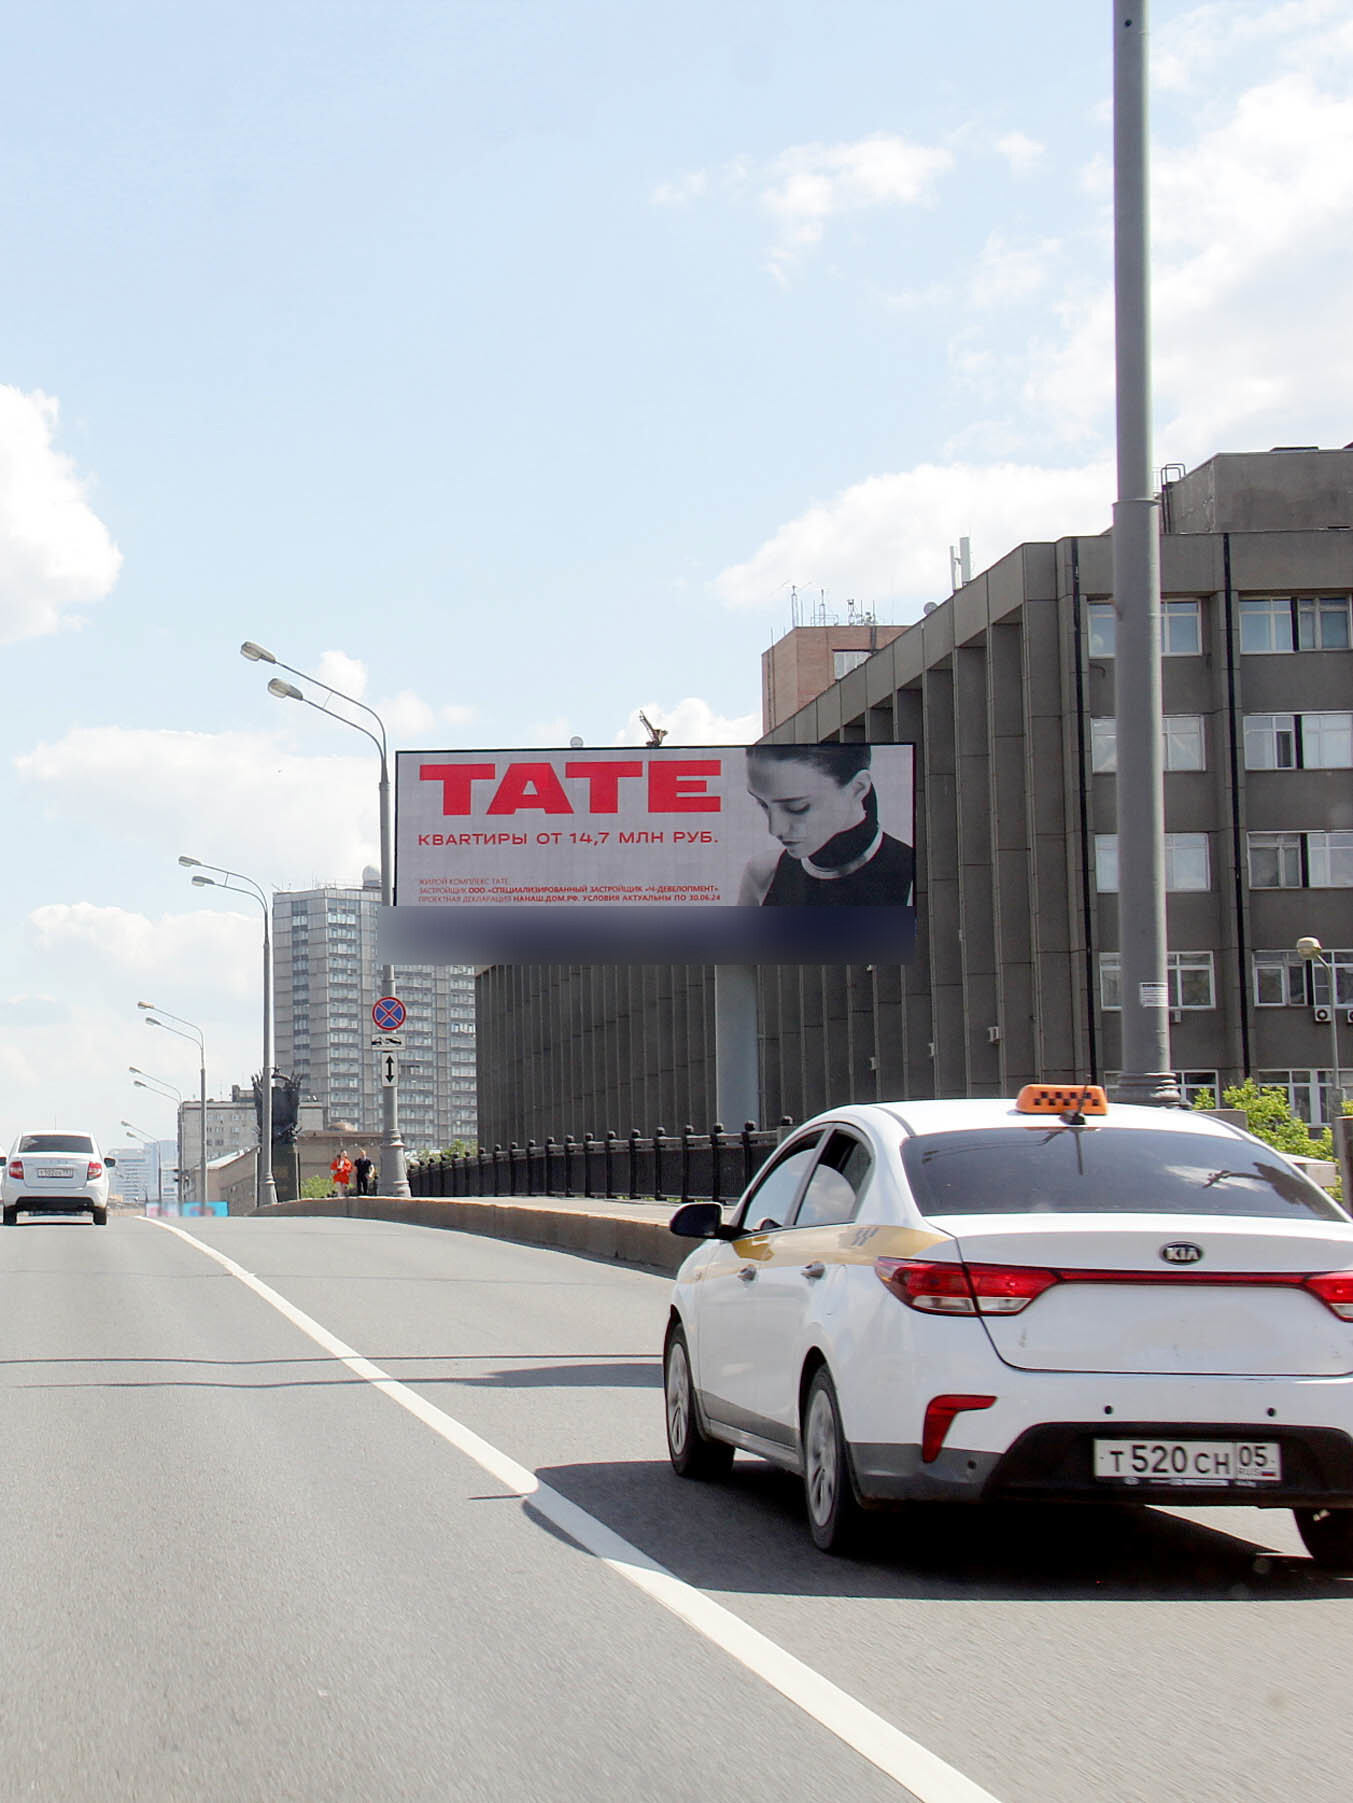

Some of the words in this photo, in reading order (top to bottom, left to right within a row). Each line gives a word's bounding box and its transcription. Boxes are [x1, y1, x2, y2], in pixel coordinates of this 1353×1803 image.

[419, 759, 722, 816] TATE
[536, 832, 563, 845] ОТ
[569, 831, 610, 846] 14,7
[618, 831, 664, 844] МЛН
[673, 831, 719, 844] РУБ.
[468, 886, 485, 894] ООО
[590, 884, 643, 894] ЗАСТРОЙЩИК
[583, 894, 620, 902] УСЛОВИЯ
[623, 894, 672, 902] АКТУАЛЬНЫ
[674, 894, 687, 902] ПО
[1166, 1247, 1199, 1260] KIA
[1238, 1445, 1268, 1467] 05
